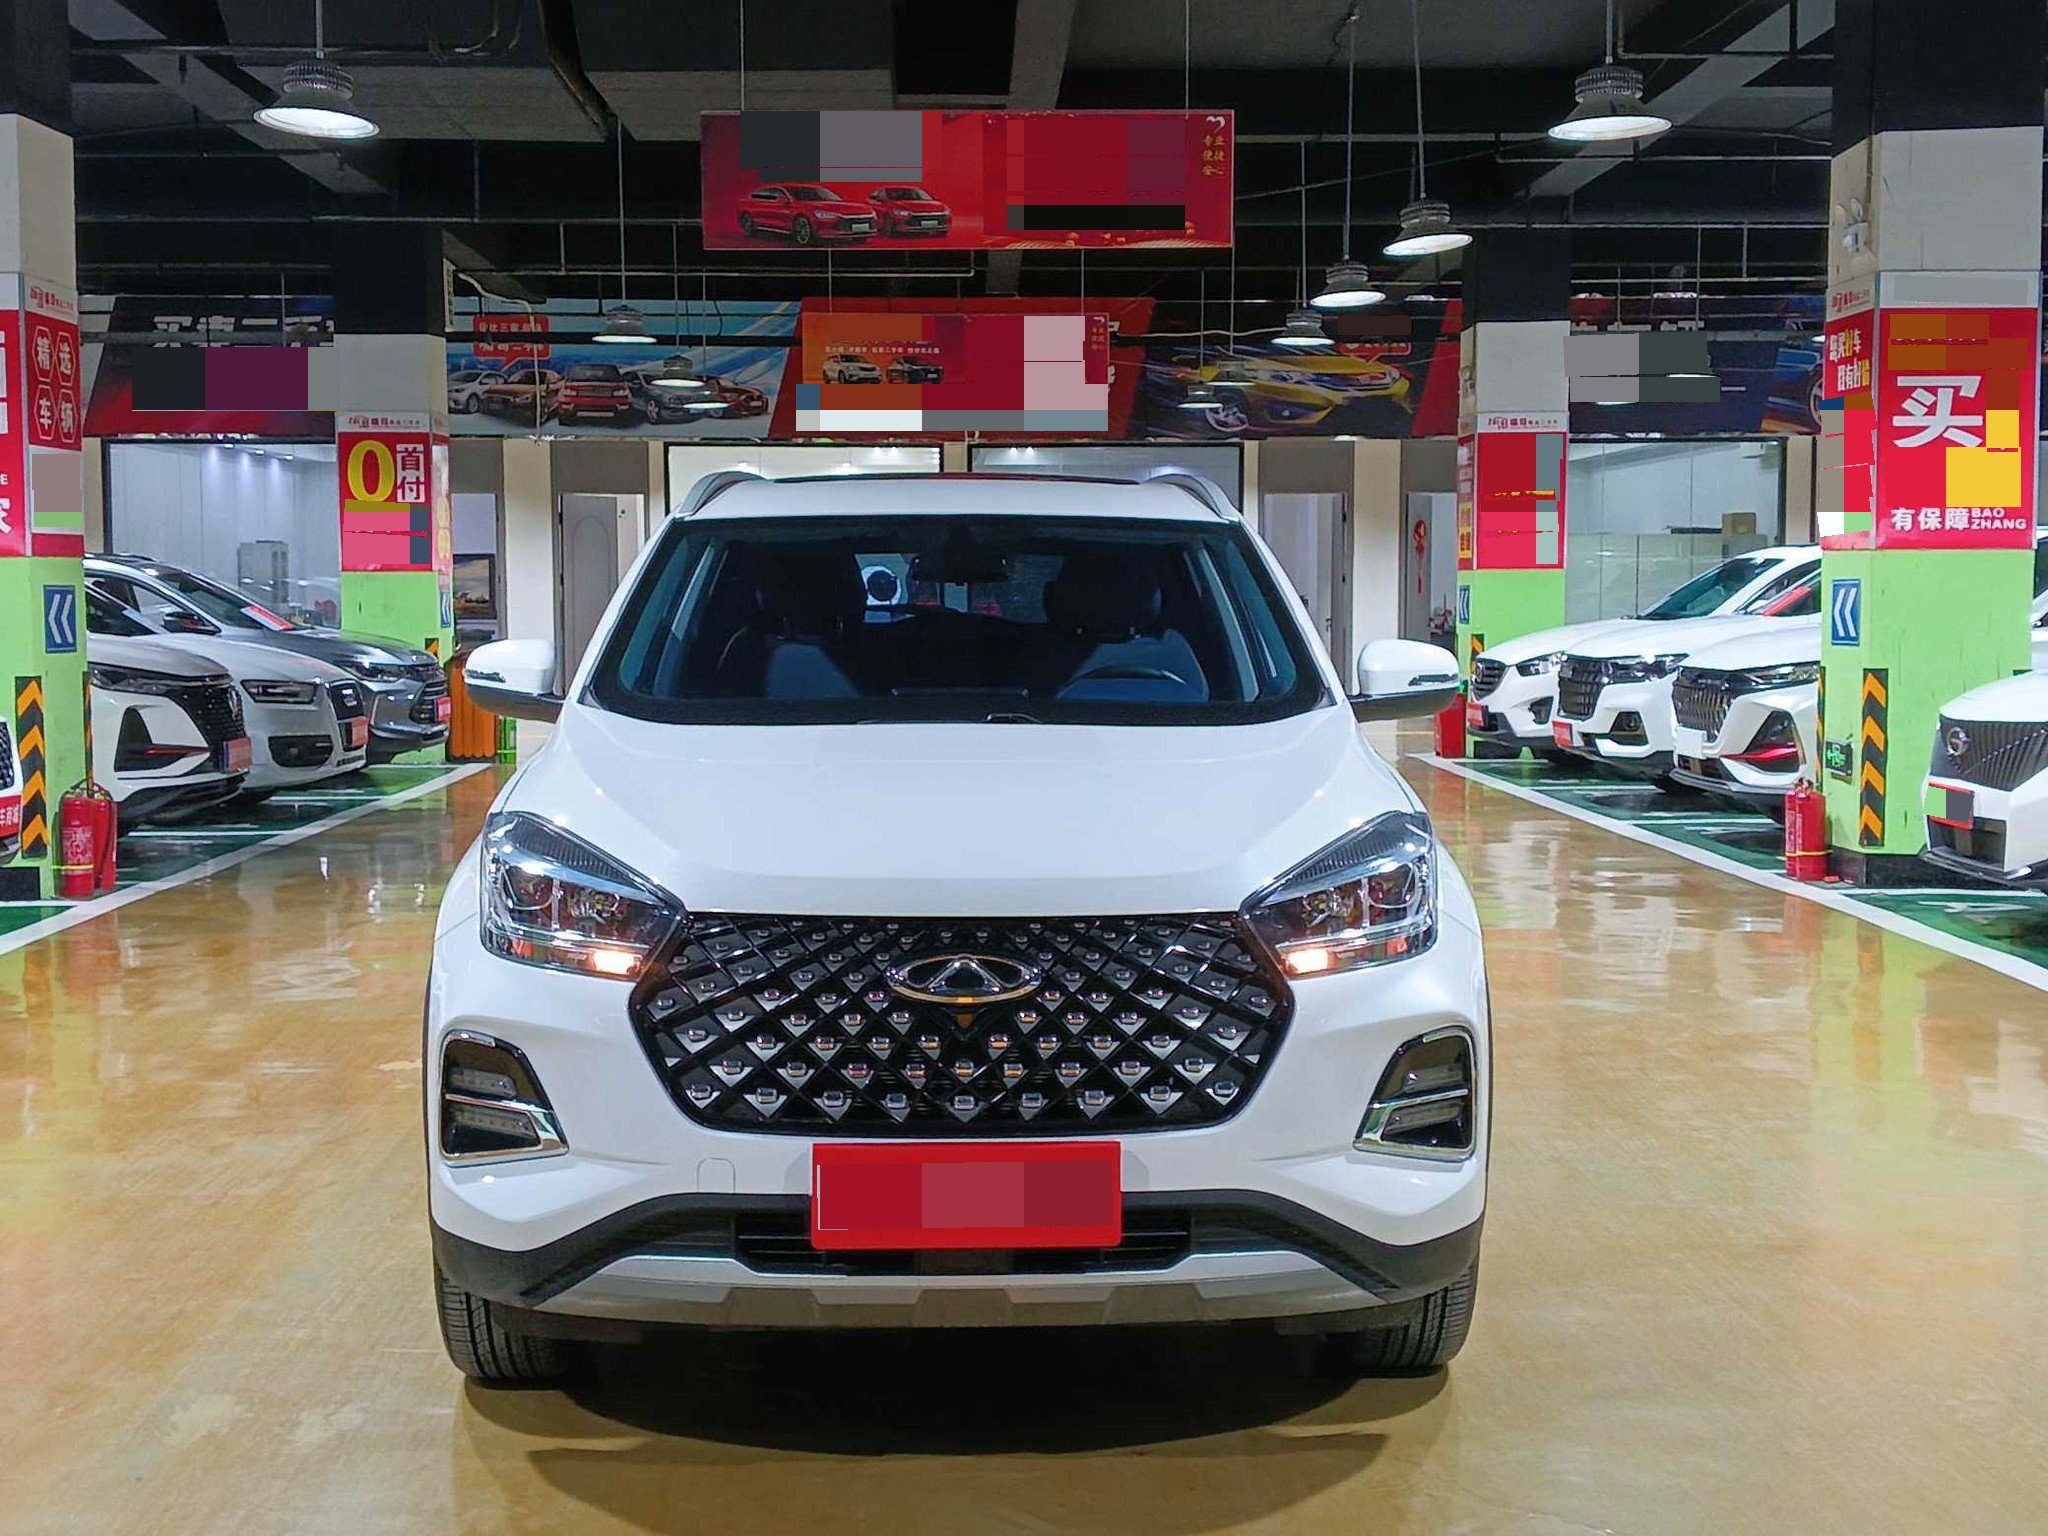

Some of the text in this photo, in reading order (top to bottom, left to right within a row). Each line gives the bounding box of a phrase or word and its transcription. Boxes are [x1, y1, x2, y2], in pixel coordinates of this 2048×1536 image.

[37, 336, 71, 375] 精选
[39, 397, 73, 434] 车辆
[1892, 375, 1984, 448] 买
[396, 444, 425, 502] 首付
[1890, 507, 1970, 531] 有保障
[1970, 519, 2026, 530] ZHANG
[1971, 508, 2005, 518] BAO
